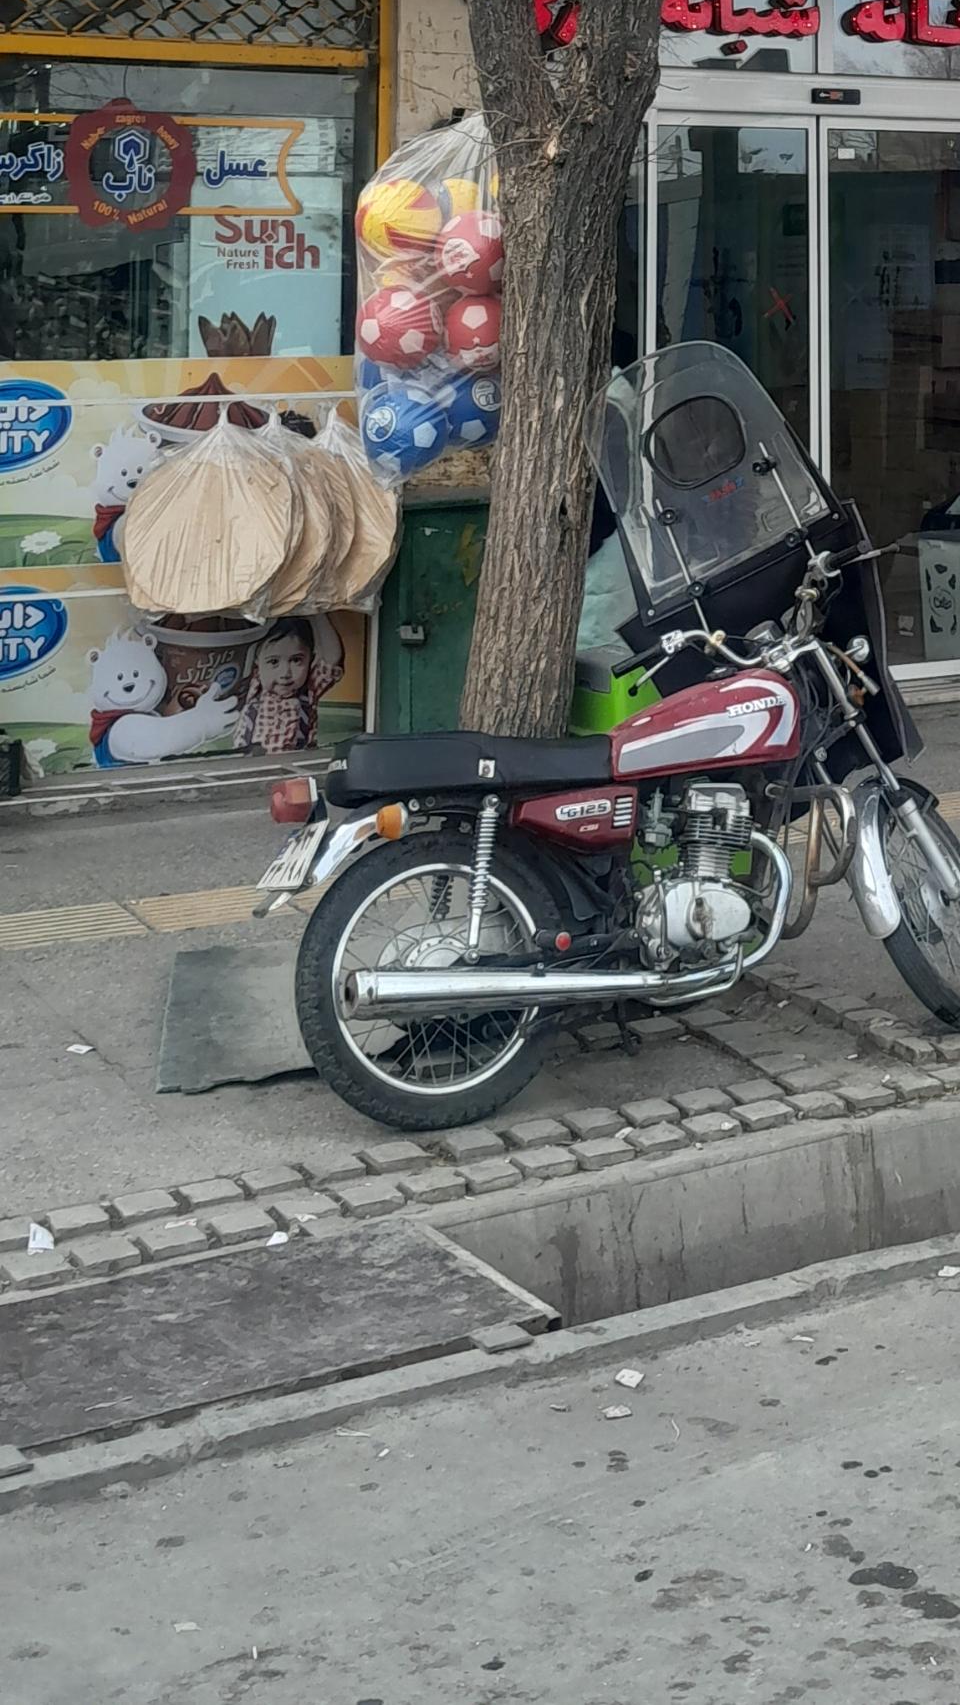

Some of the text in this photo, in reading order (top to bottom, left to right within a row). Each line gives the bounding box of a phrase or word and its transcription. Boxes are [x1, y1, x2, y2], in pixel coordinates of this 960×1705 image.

[203, 150, 270, 189] عسل
[102, 163, 156, 202] ناب
[127, 198, 169, 225] Natural
[216, 246, 259, 259] Nature
[226, 259, 259, 270] Fresh
[727, 695, 786, 718] HONDA
